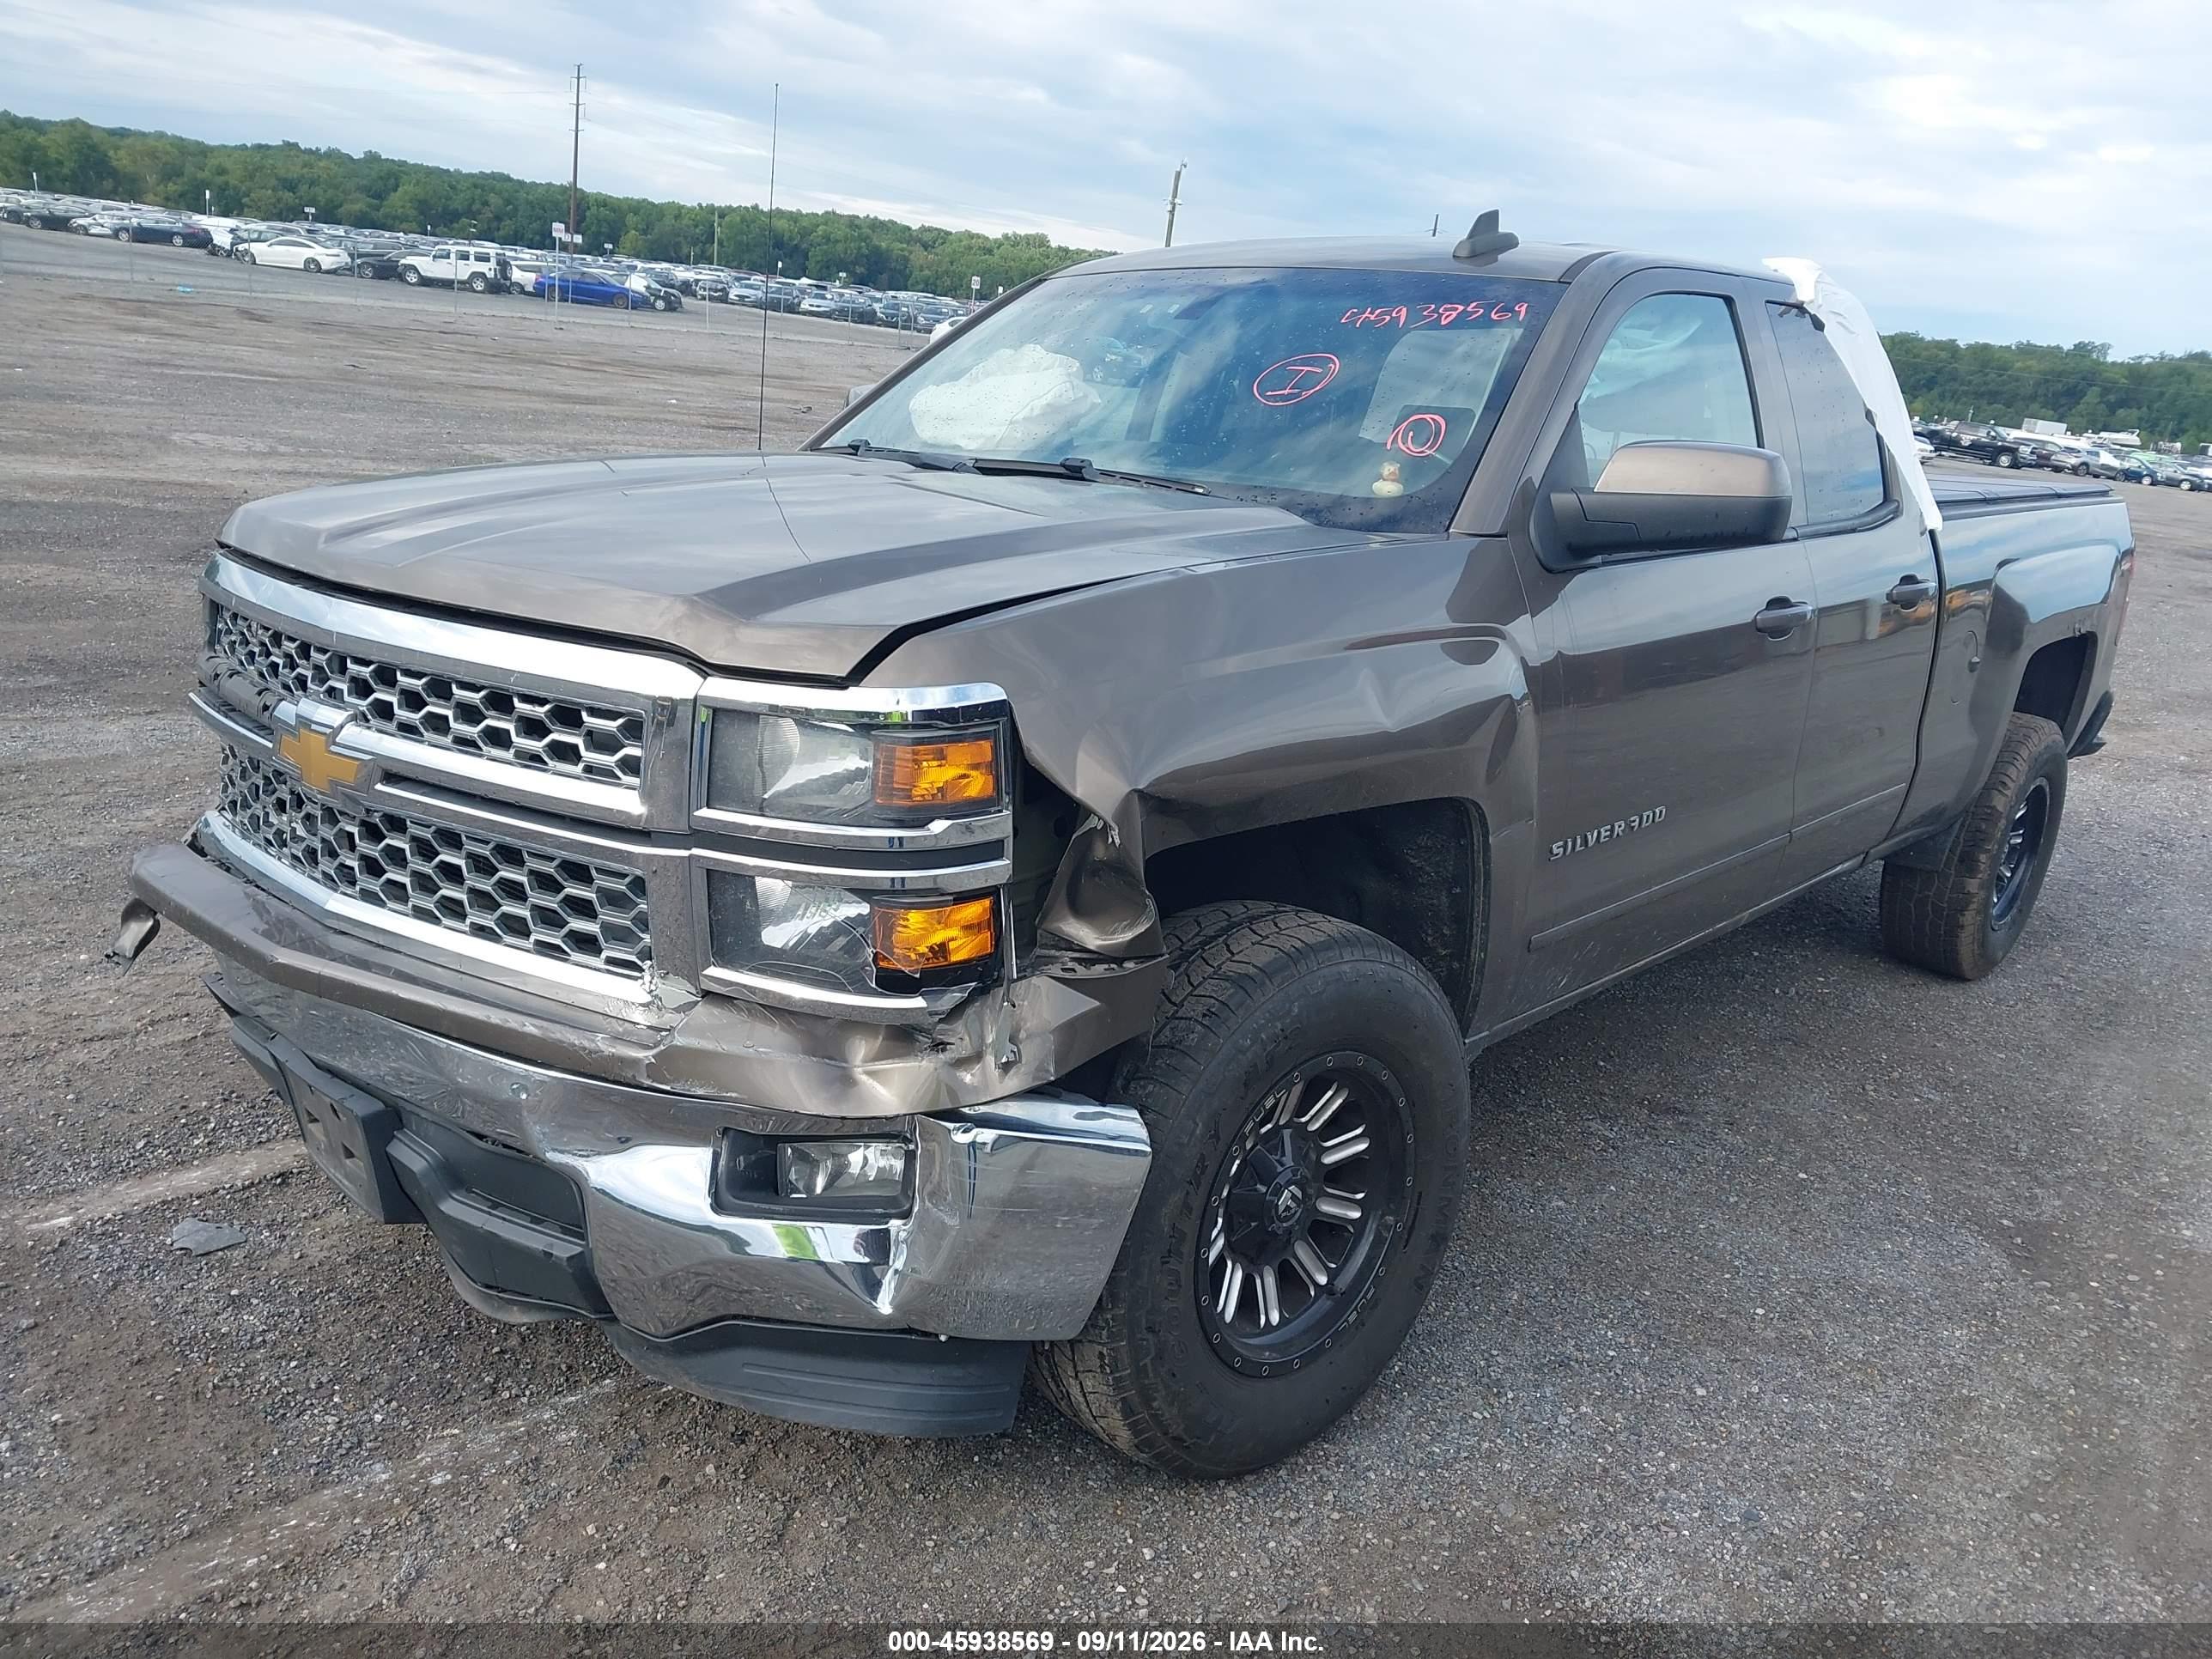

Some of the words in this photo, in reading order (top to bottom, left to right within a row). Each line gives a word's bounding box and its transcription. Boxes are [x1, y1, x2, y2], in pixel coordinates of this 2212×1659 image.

[1340, 301, 1529, 329] 45938569
[1549, 805, 1667, 861] SILVERADO
[1244, 1089, 1286, 1136] FUEL
[1338, 1285, 1376, 1332] FUEL
